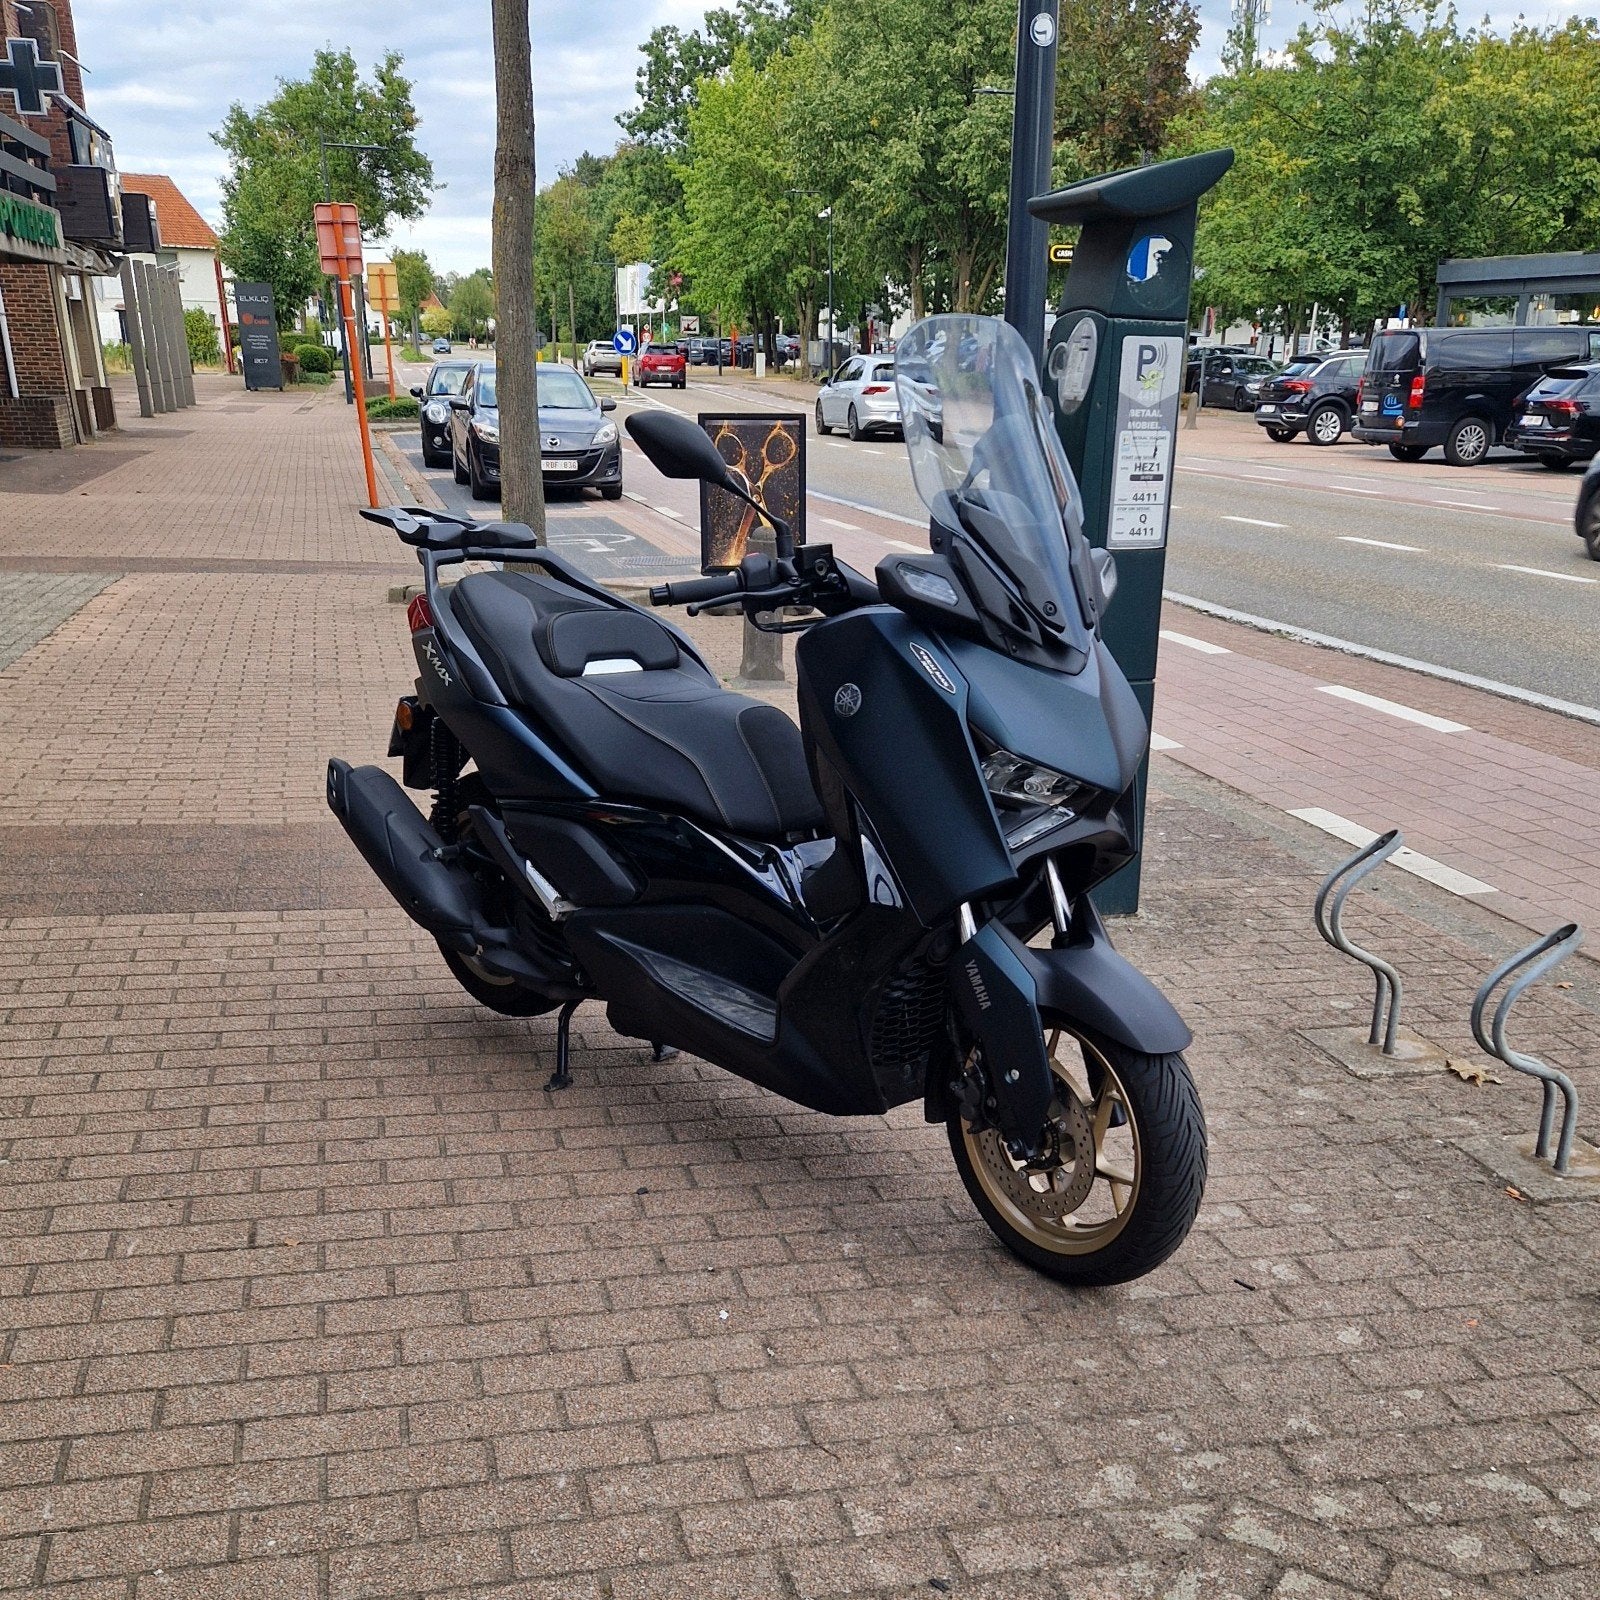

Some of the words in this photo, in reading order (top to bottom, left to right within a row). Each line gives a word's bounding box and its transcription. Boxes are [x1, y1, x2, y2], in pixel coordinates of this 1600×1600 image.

[1129, 408, 1163, 417] BETAAL
[1127, 421, 1161, 430] MOBIEL
[1134, 463, 1160, 472] HEZ1
[1132, 493, 1157, 502] 4411
[1139, 514, 1147, 524] Q
[1129, 527, 1154, 536] 4411
[421, 640, 453, 687] XMAX
[965, 959, 991, 1010] YAMAHA
